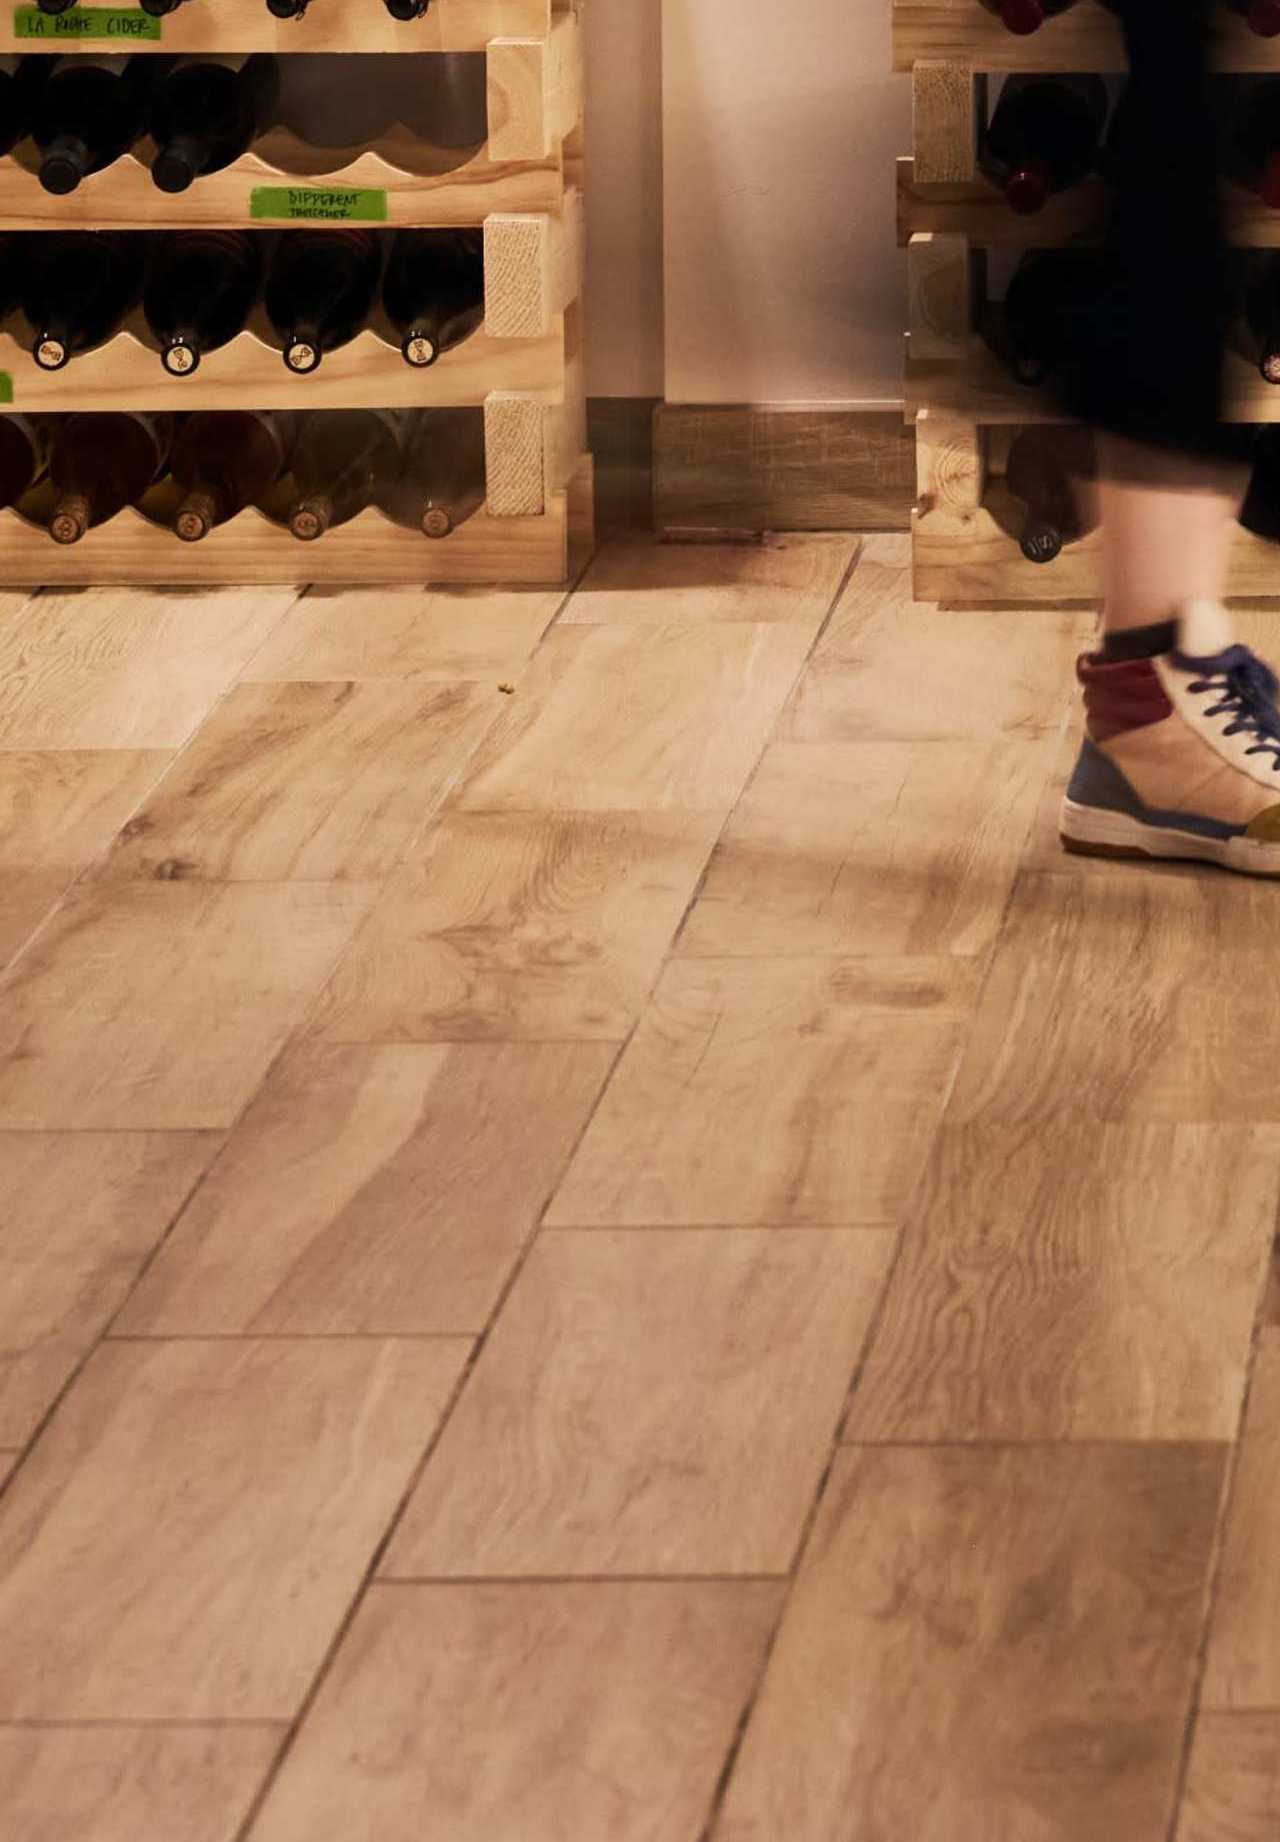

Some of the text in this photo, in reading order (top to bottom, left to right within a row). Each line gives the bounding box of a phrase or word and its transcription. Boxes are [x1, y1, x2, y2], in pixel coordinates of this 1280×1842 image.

[27, 17, 44, 33] LA
[106, 17, 150, 34] CIDER
[288, 191, 361, 206] DIFFERENT
